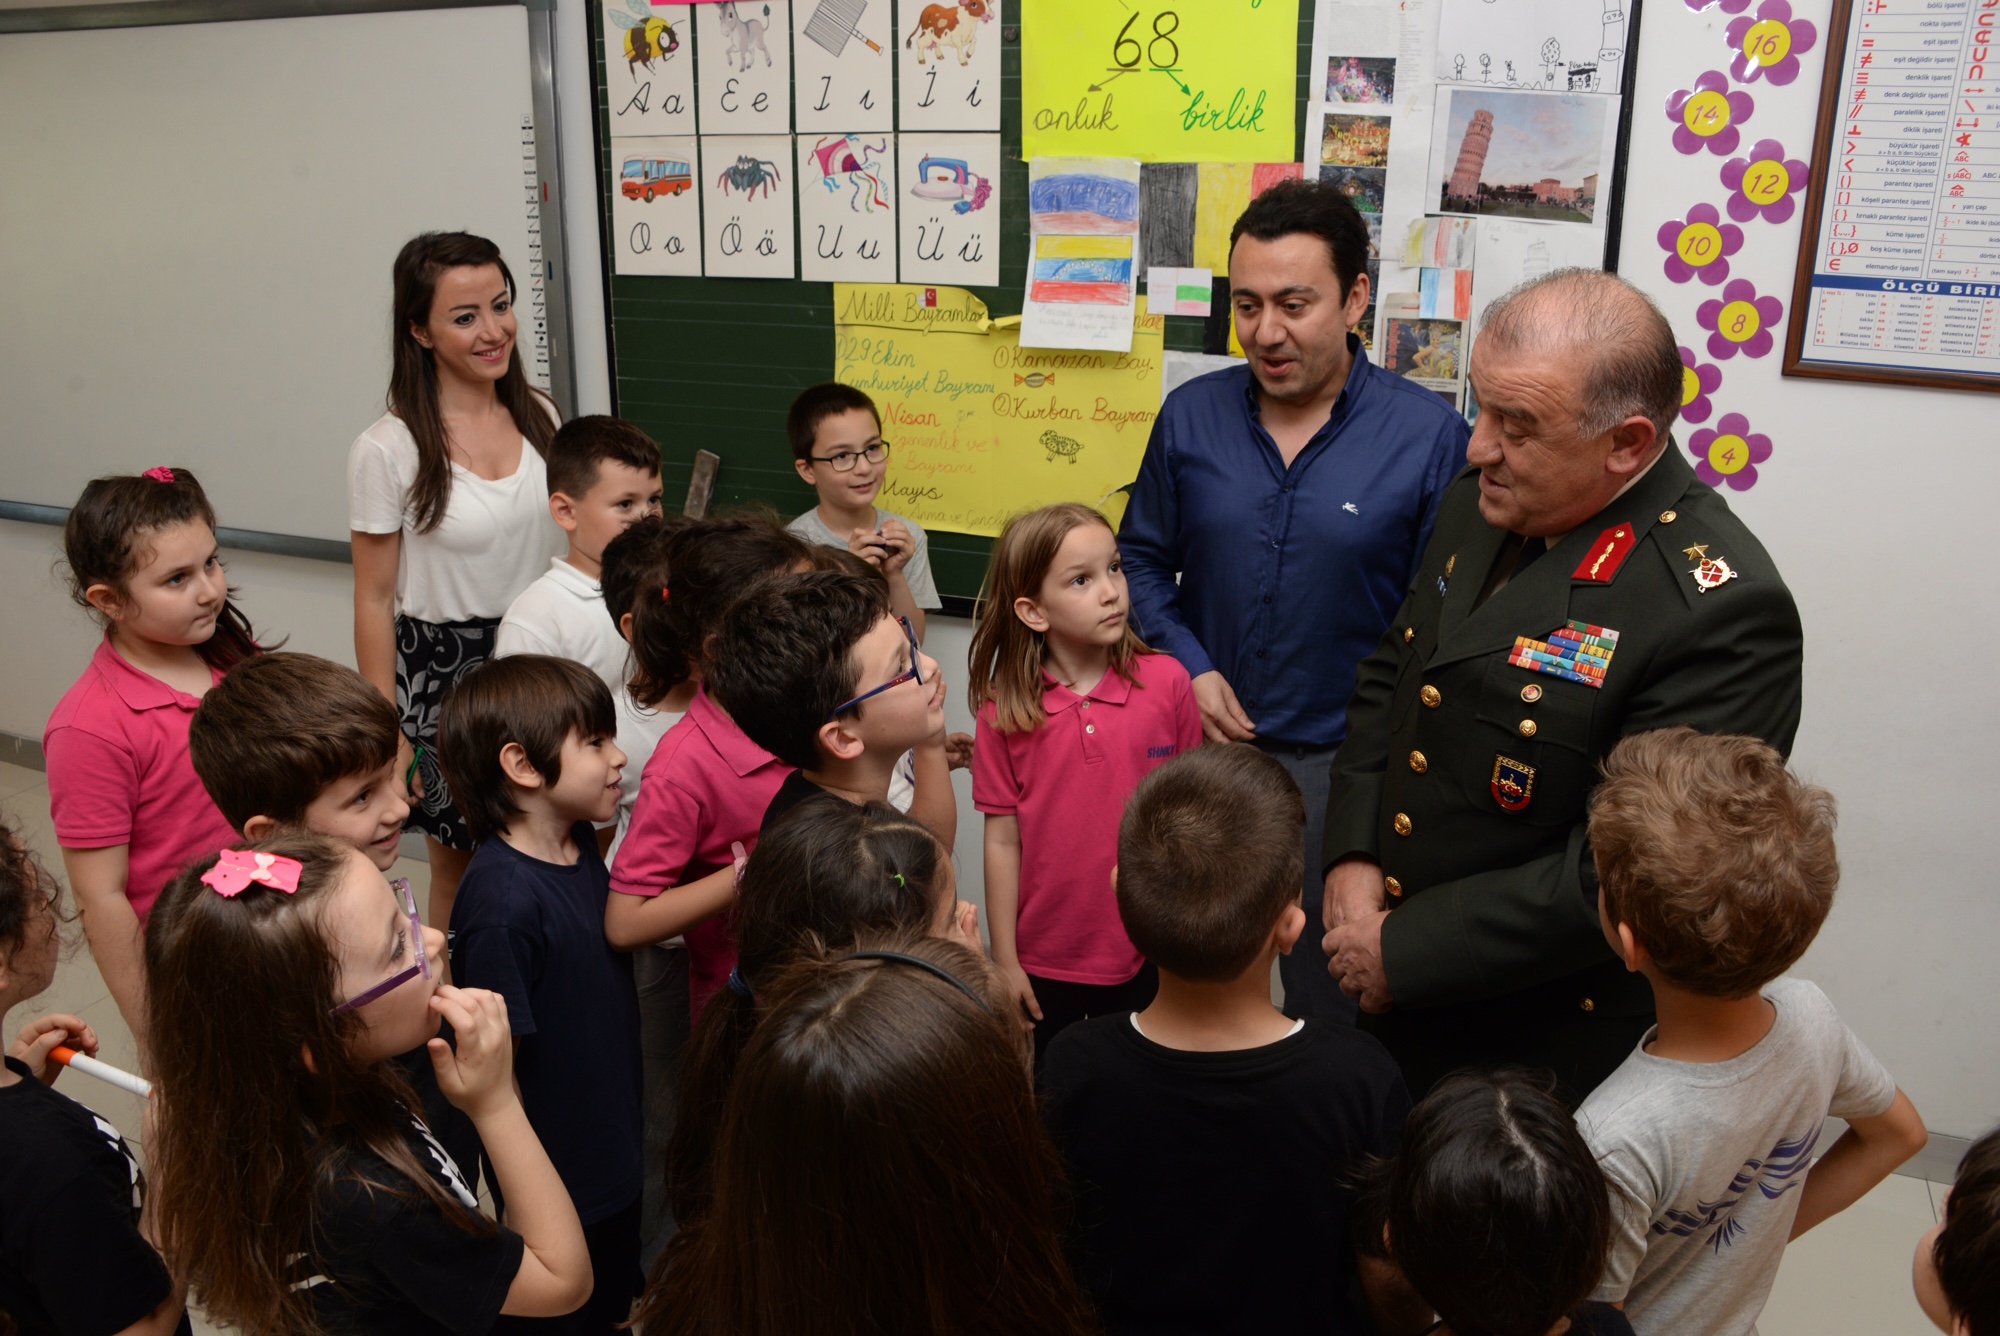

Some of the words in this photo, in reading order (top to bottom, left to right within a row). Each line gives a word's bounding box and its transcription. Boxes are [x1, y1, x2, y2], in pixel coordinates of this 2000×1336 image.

[1113, 11, 1179, 69] 68
[1751, 34, 1780, 56] 16
[617, 81, 652, 116] A
[662, 93, 685, 115] a
[752, 91, 769, 113] e
[1033, 93, 1119, 131] onluk
[1180, 87, 1267, 132] birlik
[1692, 105, 1720, 125] 14
[1751, 174, 1780, 194] 12
[664, 236, 685, 255] o
[755, 229, 777, 256] ö
[817, 224, 844, 260] U
[857, 238, 880, 260] u
[917, 216, 944, 261] Ü
[958, 233, 983, 263] ü
[1684, 236, 1712, 256] 10
[1882, 279, 1940, 294] ÖLÇÜ
[1950, 283, 2000, 297] BİRİ
[839, 290, 895, 323] Milli
[902, 292, 985, 336] Bayramlar
[1731, 314, 1747, 334] 8
[844, 336, 871, 362] 29
[872, 340, 915, 368] Ekim
[1010, 346, 1106, 370] Ramazan
[933, 369, 995, 401] Bayramı
[882, 402, 941, 427] Nisan
[1010, 395, 1083, 421] Kurban
[1089, 397, 1158, 432] Bayram
[892, 426, 960, 453] Egemenlik
[967, 438, 987, 453] ve
[904, 451, 976, 478] Bayramı
[1721, 447, 1736, 466] 4
